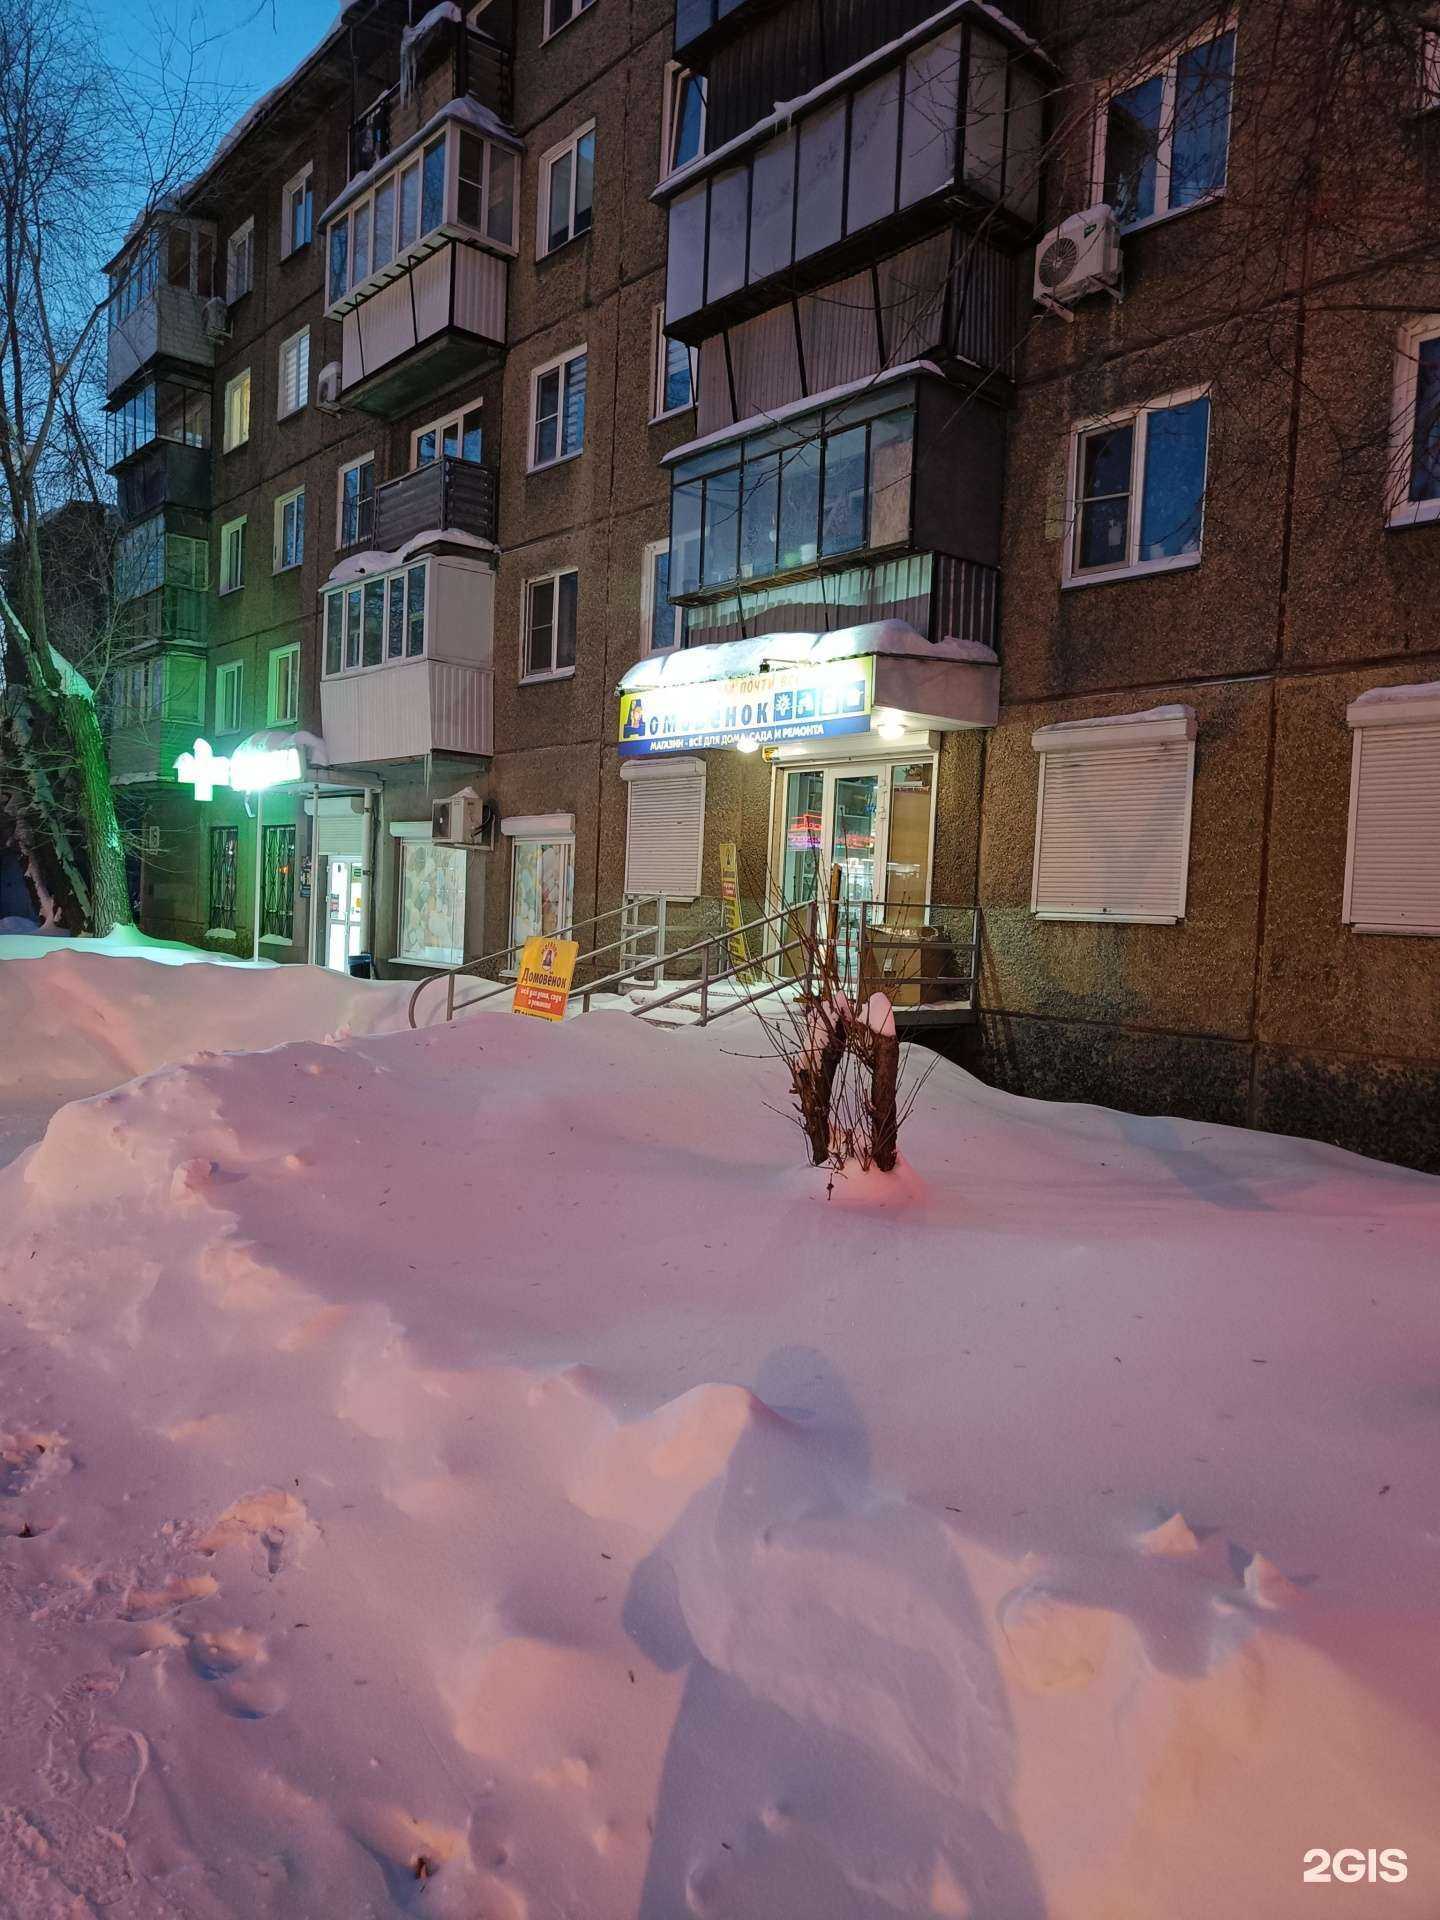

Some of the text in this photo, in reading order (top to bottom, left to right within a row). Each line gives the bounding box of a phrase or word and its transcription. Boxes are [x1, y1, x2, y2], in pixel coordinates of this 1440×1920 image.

[650, 738, 684, 751] МАГАЗИН
[704, 735, 720, 748] ДЛЯ
[748, 729, 773, 742] САДА
[774, 728, 782, 739] И
[782, 723, 824, 737] РЕМОНТА
